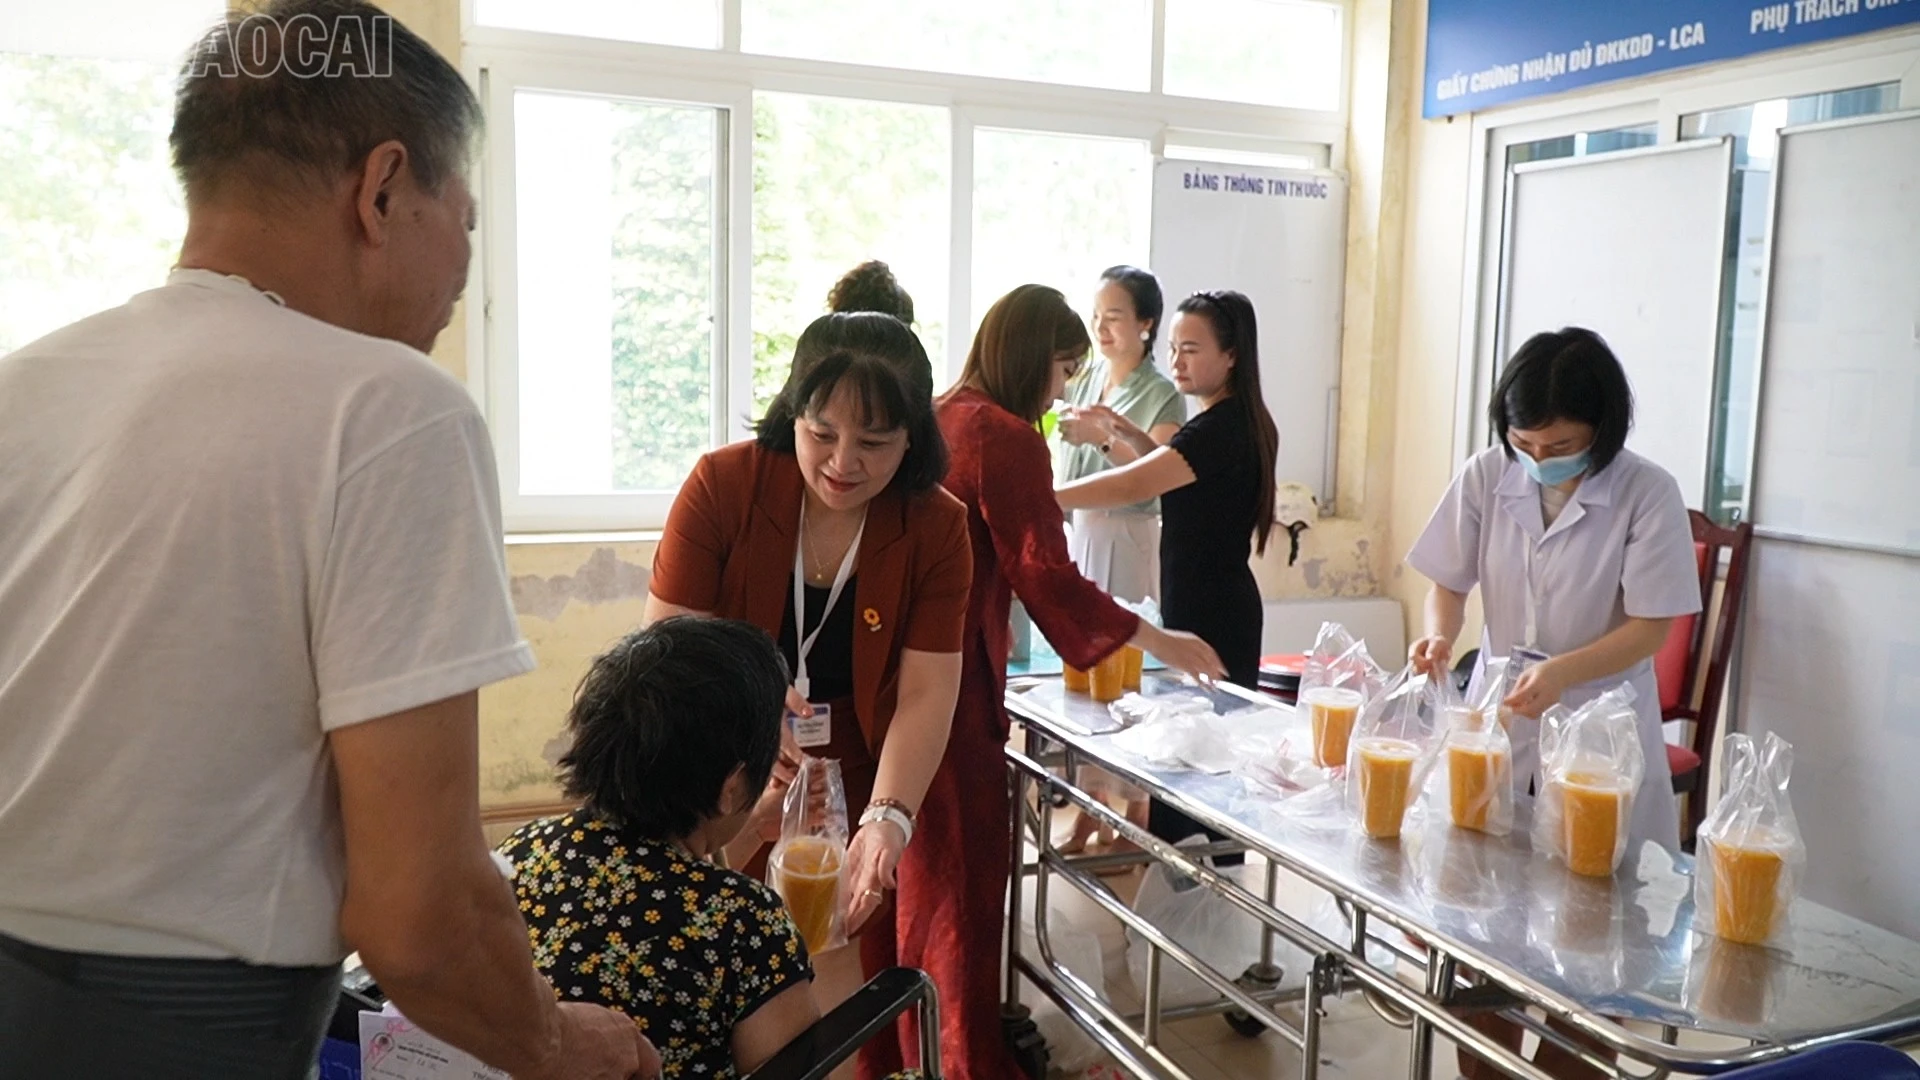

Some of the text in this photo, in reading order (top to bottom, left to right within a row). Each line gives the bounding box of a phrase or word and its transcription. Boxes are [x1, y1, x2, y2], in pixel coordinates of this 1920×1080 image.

[1750, 3, 1790, 34] PHỤ
[1521, 52, 1567, 82] NHẬN
[1669, 21, 1705, 50] LCA
[1268, 179, 1287, 197] TIN
